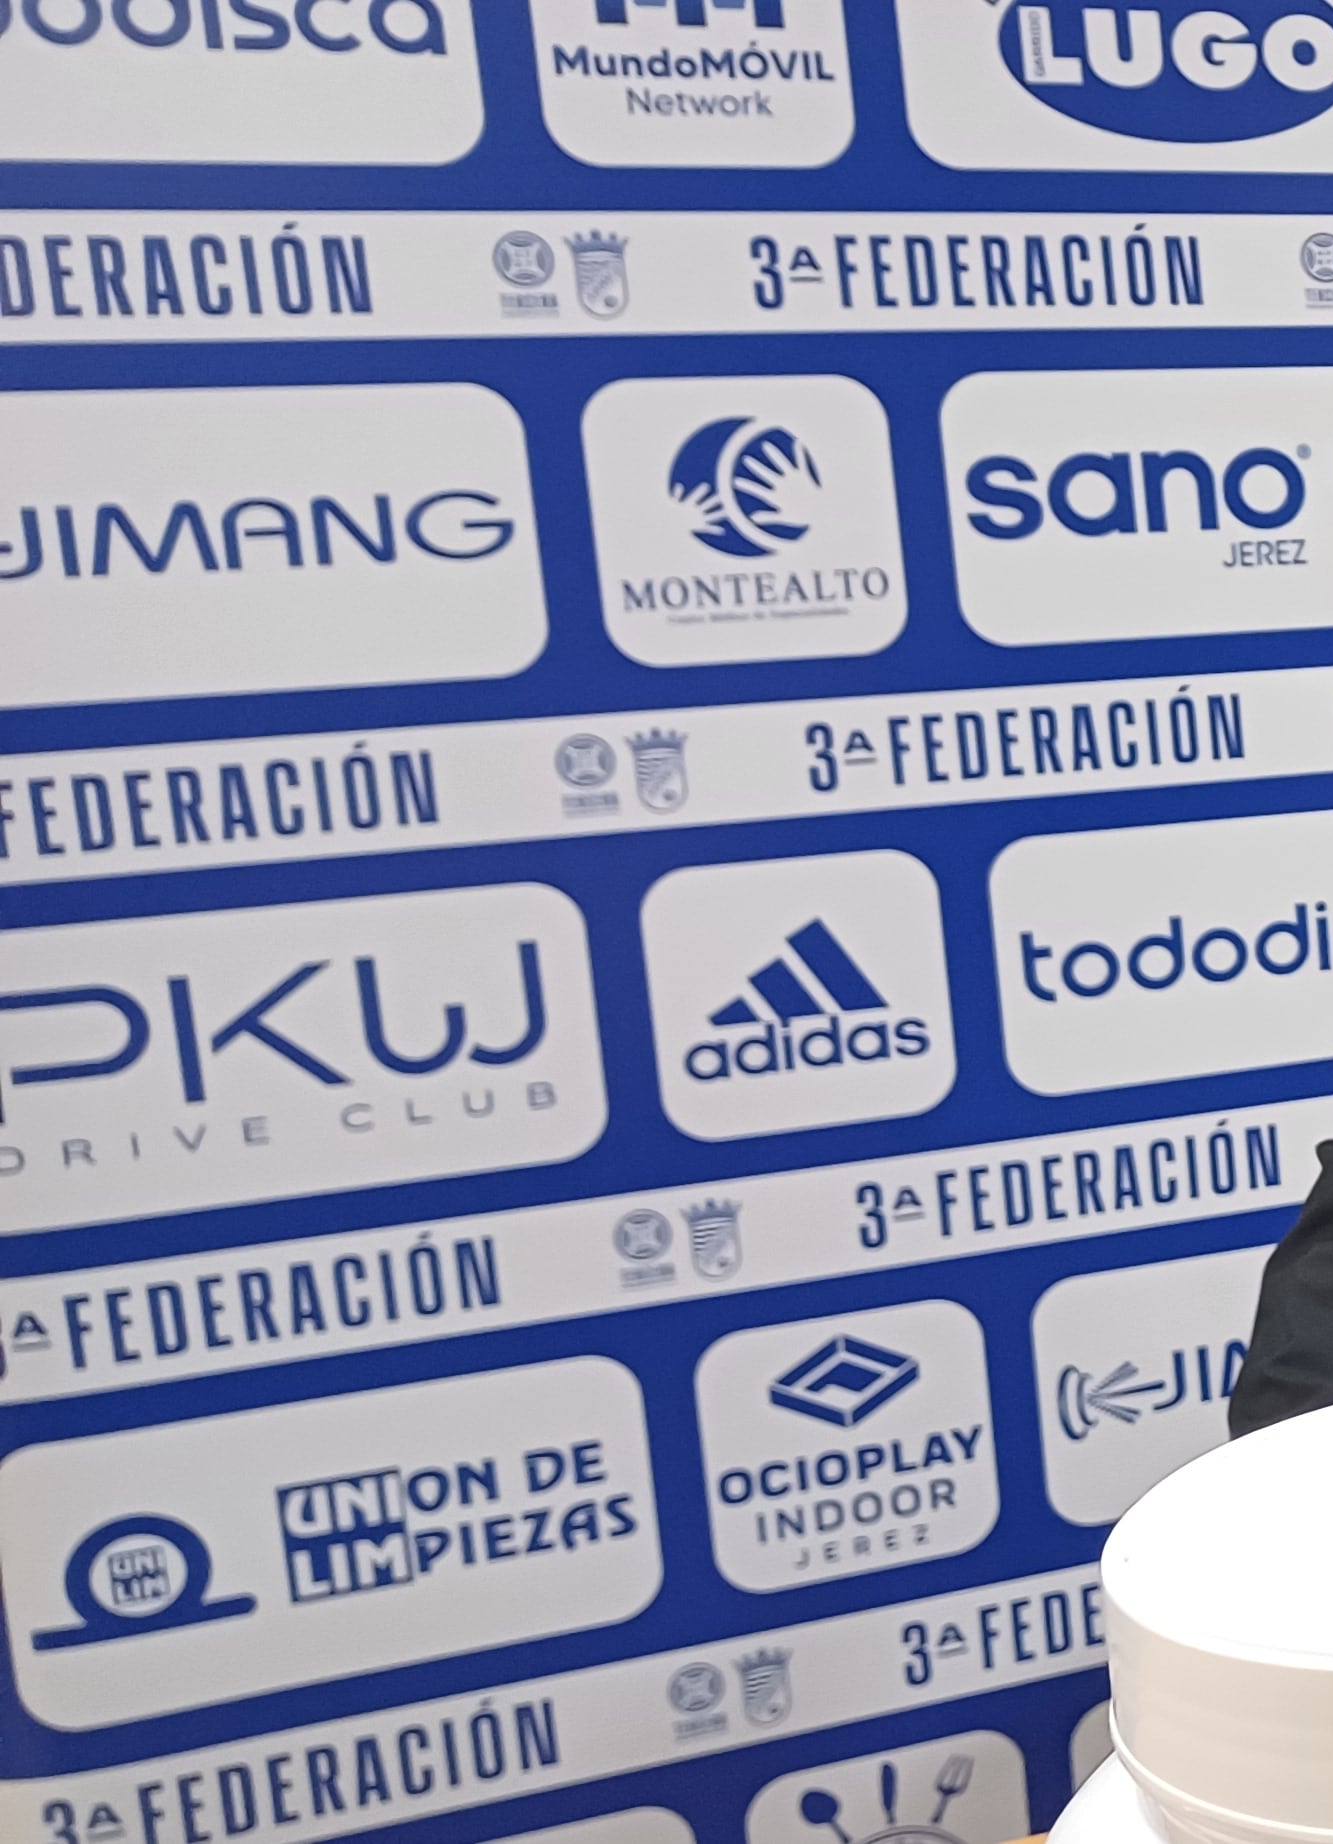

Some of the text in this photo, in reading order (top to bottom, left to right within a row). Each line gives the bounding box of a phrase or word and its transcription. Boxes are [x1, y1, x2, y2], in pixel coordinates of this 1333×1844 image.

[552, 40, 835, 80] MundoMÓVIL
[626, 87, 774, 117] Network
[838, 223, 1202, 309] FEDERACIÓN
[620, 566, 890, 613] MONTEALTO
[1222, 538, 1308, 569] JEREZ
[888, 684, 1246, 787] FEDERACIÓN
[684, 1011, 930, 1082] adidas
[340, 1080, 558, 1133] CLUB
[937, 1119, 1283, 1238] FEDERACIÓN
[62, 1230, 502, 1372] FEDERACIÓN
[277, 1438, 608, 1540] UNION DE
[718, 1423, 983, 1505] OCIOPLAY
[289, 1492, 639, 1603] LIMPIEZAS
[754, 1476, 957, 1545] INDOOR
[793, 1522, 931, 1571] JEREZ
[137, 1696, 561, 1844] FEDERACIÓN
